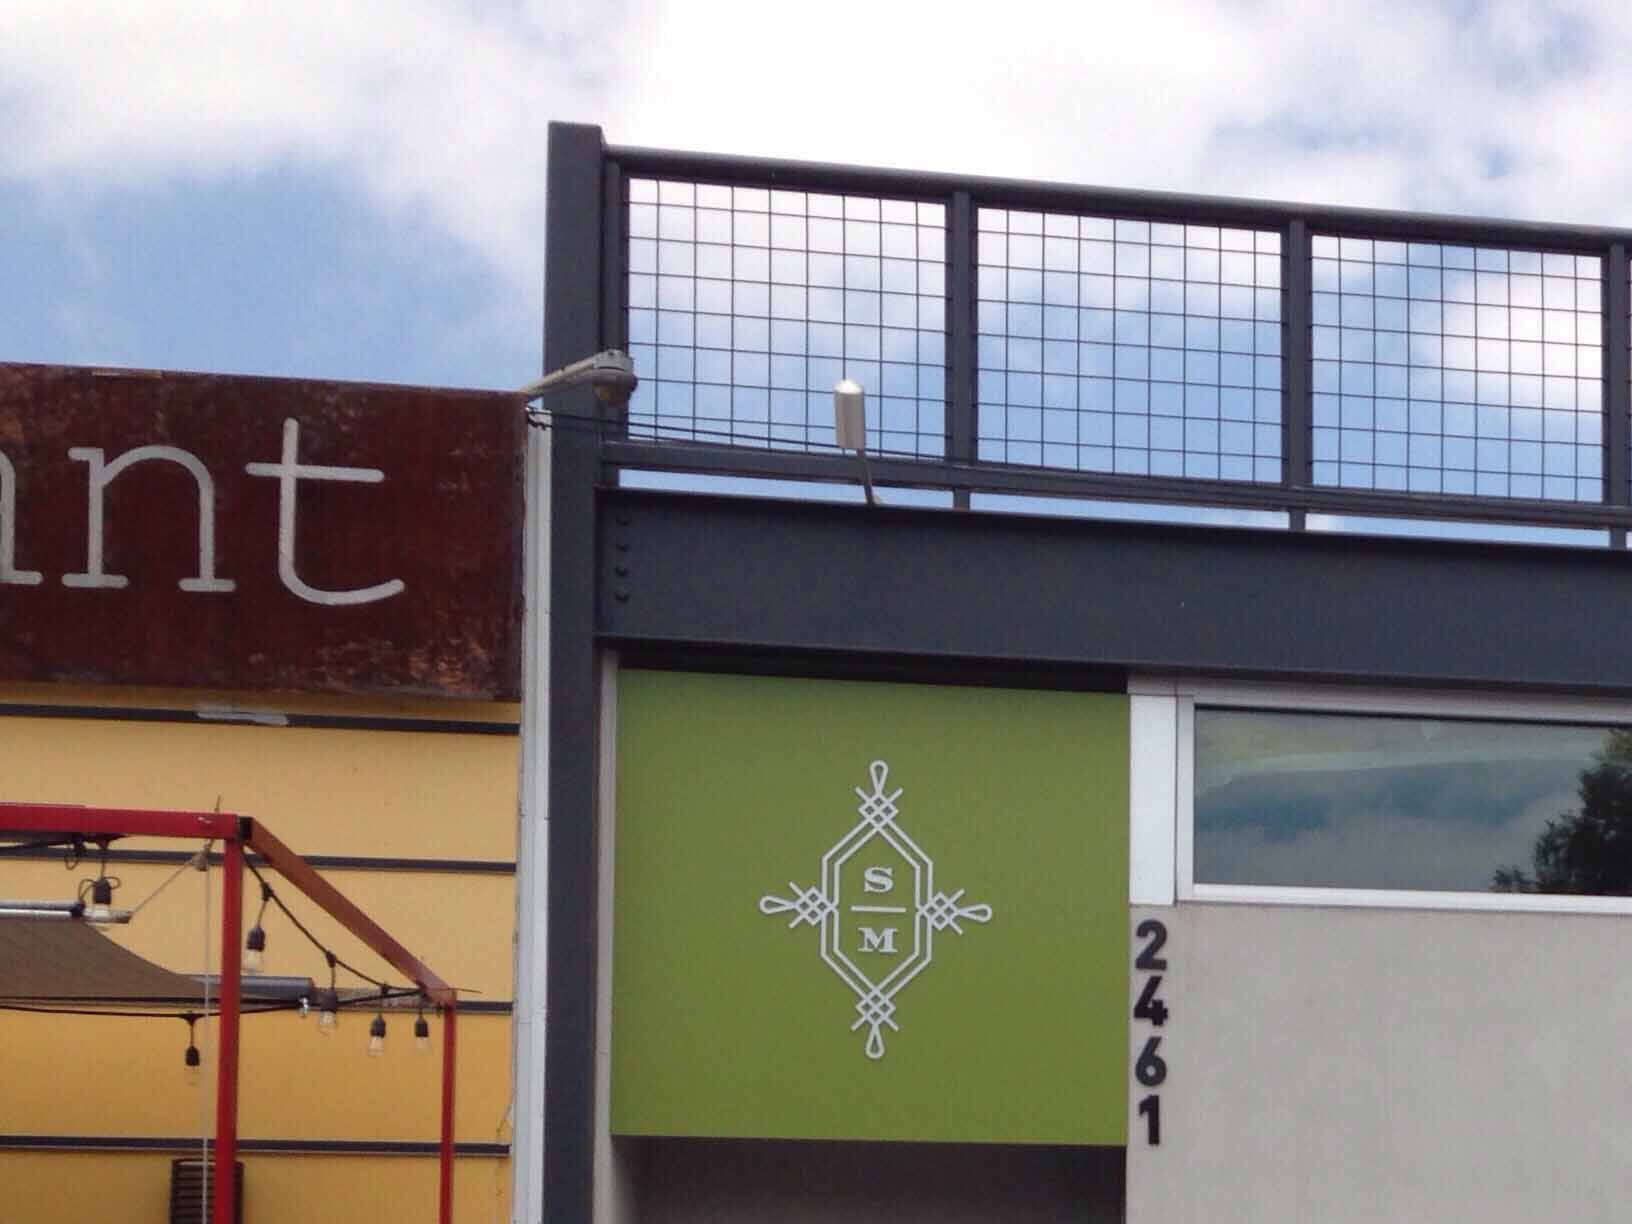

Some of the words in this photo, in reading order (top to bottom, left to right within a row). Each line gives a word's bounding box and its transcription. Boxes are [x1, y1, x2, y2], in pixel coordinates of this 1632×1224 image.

[863, 866, 893, 892] S
[858, 927, 898, 953] M
[1133, 920, 1169, 1146] 2461
